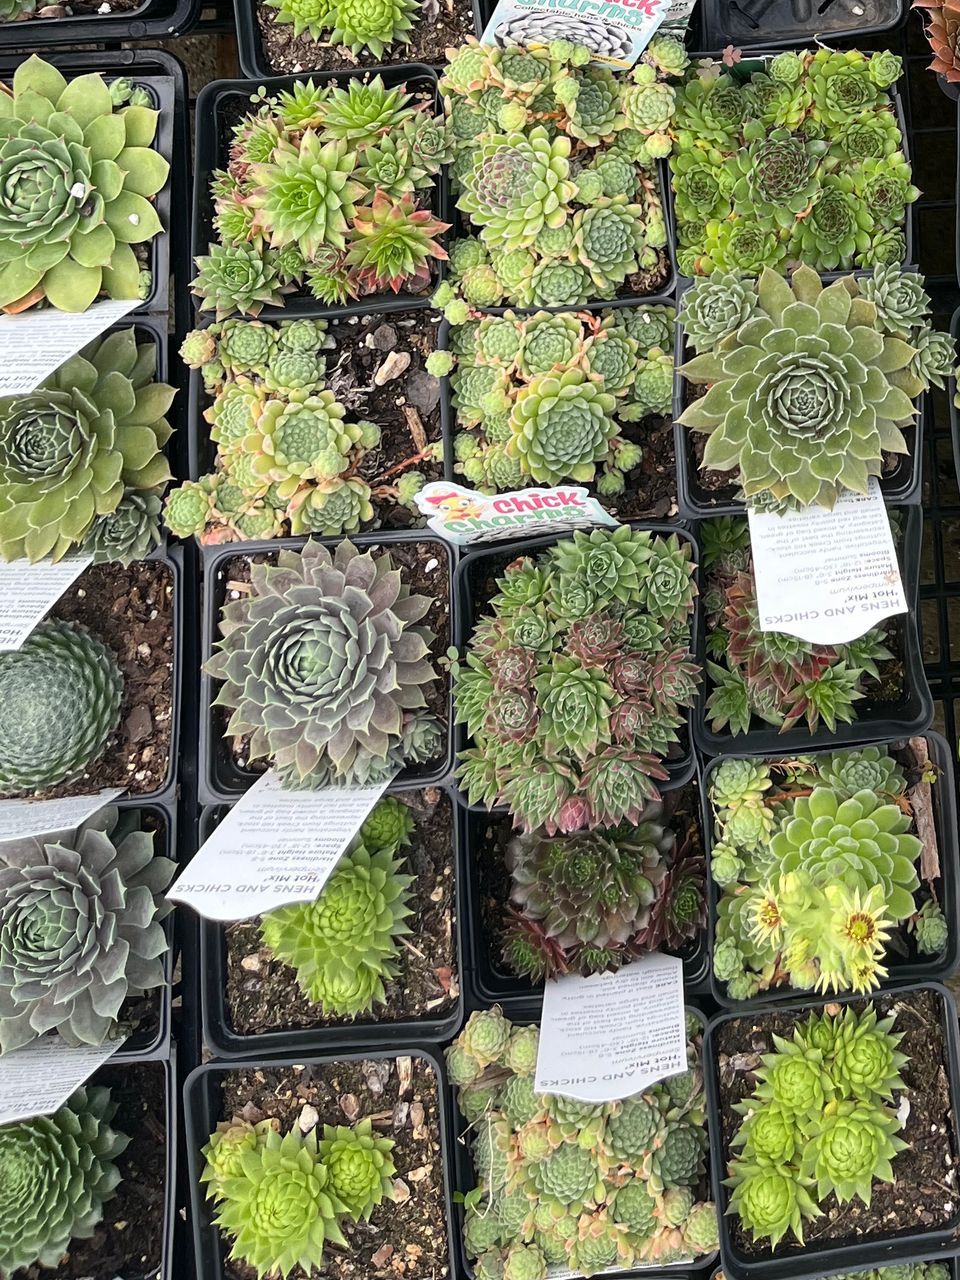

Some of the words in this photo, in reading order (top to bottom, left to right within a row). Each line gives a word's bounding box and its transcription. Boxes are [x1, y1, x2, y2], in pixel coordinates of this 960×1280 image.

[514, 4, 570, 16] Collectable
[493, 491, 586, 514] Chick
[824, 605, 856, 617] AND
[860, 599, 900, 612] HENS
[764, 610, 819, 625] CHICKS
[175, 884, 231, 893] CHICKS
[235, 884, 271, 893] AND
[274, 885, 315, 893] HENS
[640, 1061, 681, 1074] HENS
[602, 1069, 635, 1080] AND
[539, 1076, 597, 1087] CHICKS
